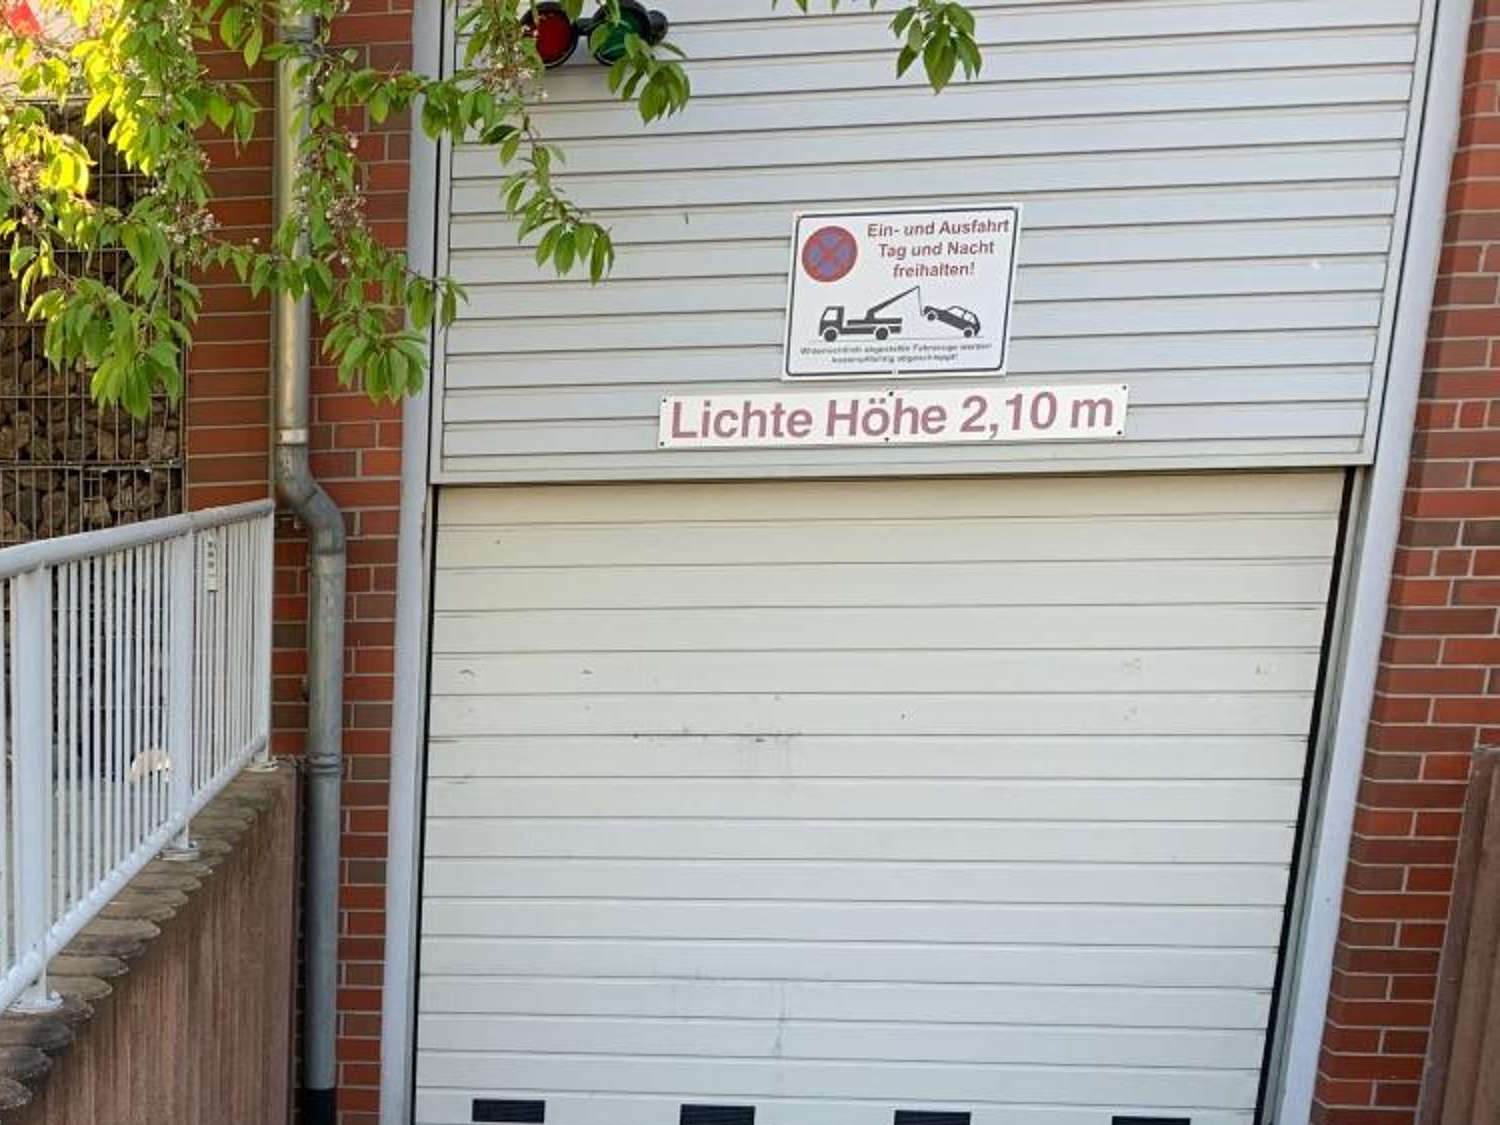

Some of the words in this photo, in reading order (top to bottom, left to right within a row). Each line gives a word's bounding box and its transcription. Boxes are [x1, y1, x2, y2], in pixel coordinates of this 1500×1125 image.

[867, 223, 900, 237] Ein-
[904, 221, 935, 235] und
[939, 219, 1009, 235] Ausfahrt
[878, 243, 906, 260] Tag
[911, 242, 942, 256] und
[947, 240, 995, 255] Nacht
[892, 261, 975, 278] freihalten!
[671, 401, 813, 439] Lichte
[826, 397, 947, 437] Höhe
[961, 391, 1057, 440] 2,10
[1071, 396, 1114, 429] m
